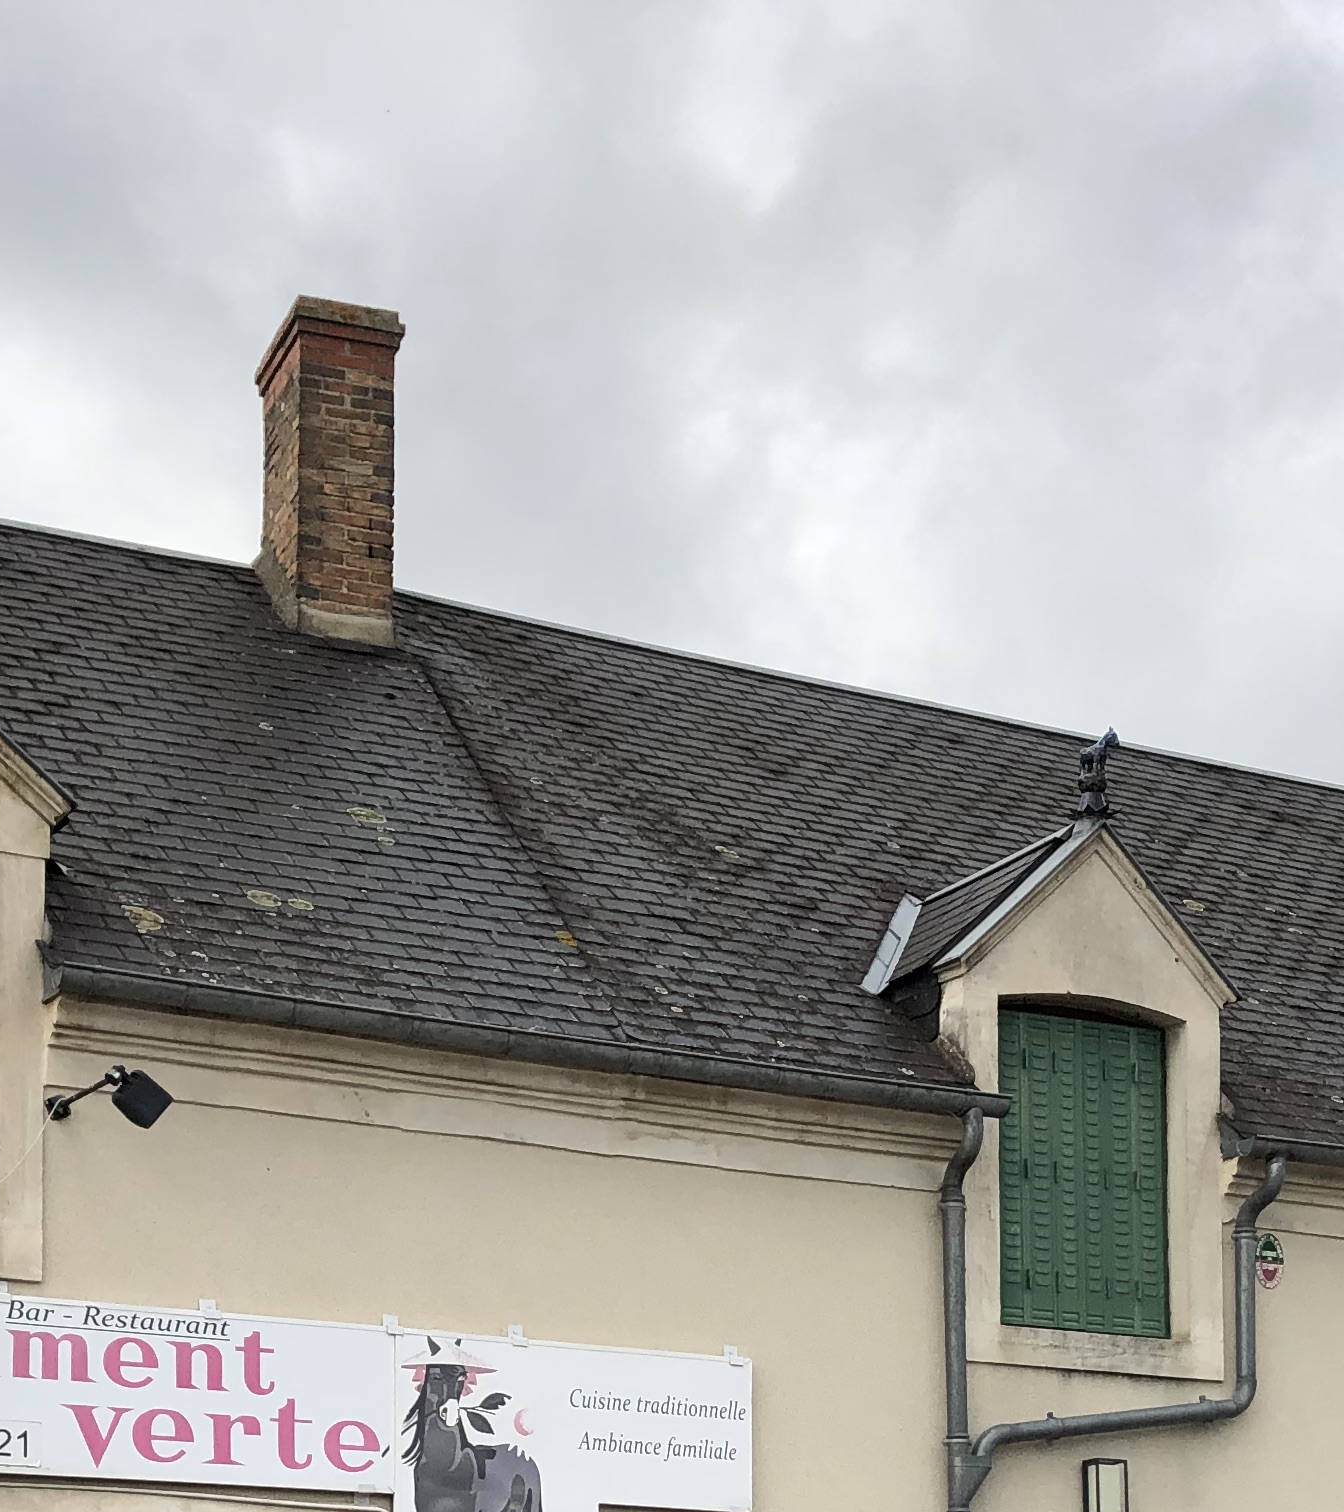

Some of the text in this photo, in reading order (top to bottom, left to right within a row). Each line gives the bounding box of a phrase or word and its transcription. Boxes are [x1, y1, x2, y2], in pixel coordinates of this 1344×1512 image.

[6, 1299, 54, 1323] Bar
[83, 1305, 230, 1337] Restaurant
[569, 1388, 747, 1421] Cuisine traditionnelle
[59, 1398, 381, 1473] verte
[578, 1431, 737, 1462] Ambiance familiale
